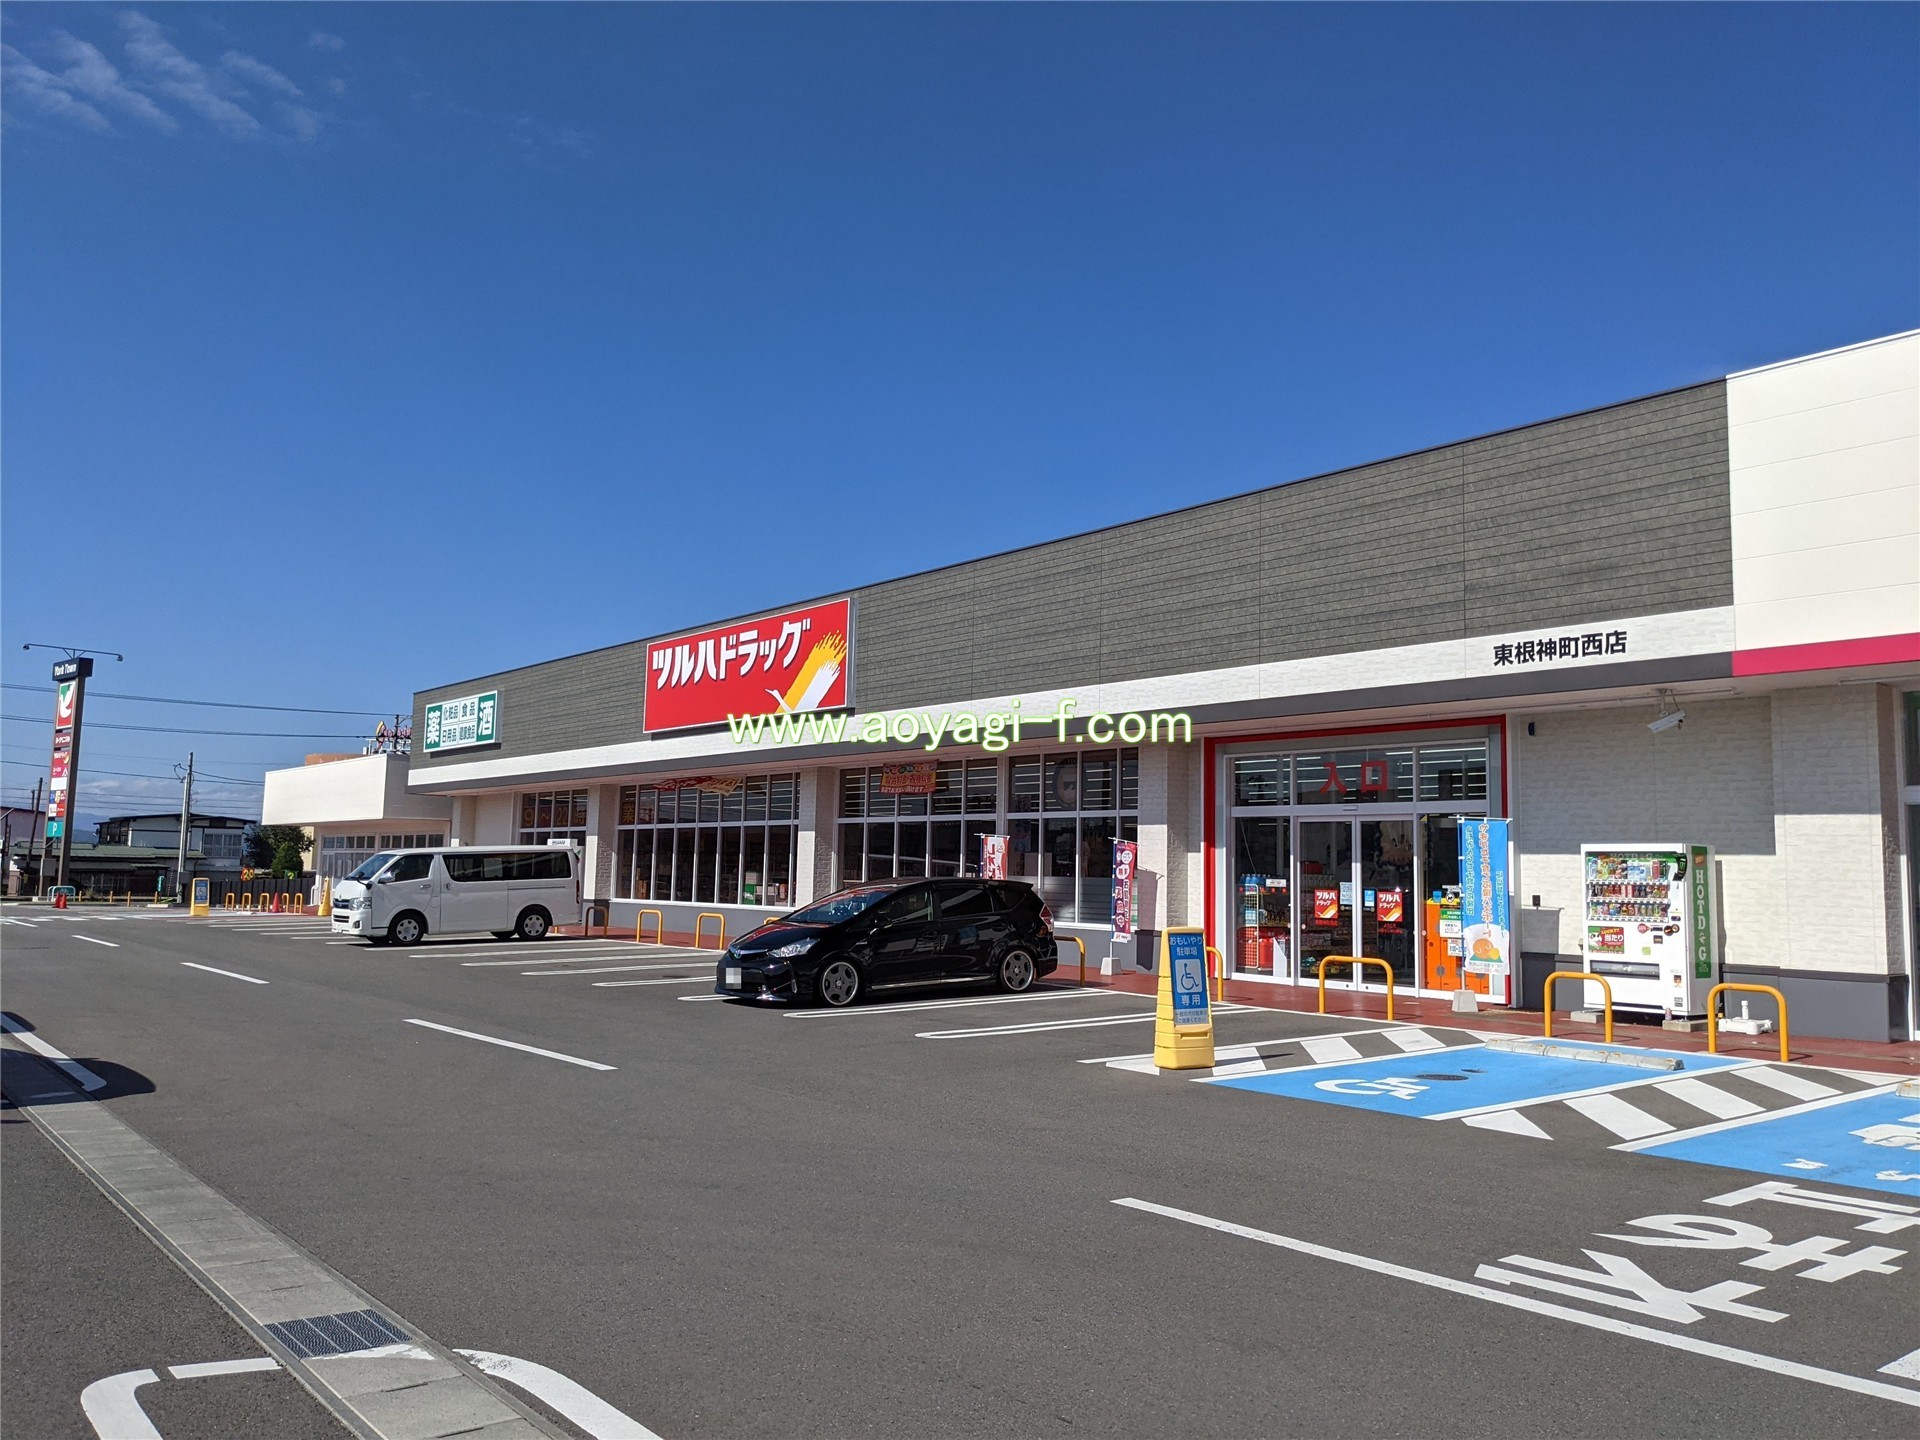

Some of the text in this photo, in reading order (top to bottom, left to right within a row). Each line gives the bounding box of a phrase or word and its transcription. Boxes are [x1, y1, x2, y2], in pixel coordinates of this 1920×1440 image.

[652, 617, 811, 690] ツルハドラッグ
[1493, 630, 1627, 667] 東根神町西店
[443, 704, 459, 721] 化粧品
[461, 701, 475, 718] 食品
[478, 700, 494, 736] 酒
[426, 710, 441, 745] 薬
[442, 727, 457, 743] 日用品
[1319, 759, 1388, 795] 入口
[1316, 891, 1336, 900] ツルハ
[1379, 894, 1401, 902] ツルハ
[1169, 936, 1203, 945] おもいやり
[1604, 933, 1624, 942] 当たり
[1176, 946, 1198, 956] 駐車場
[1181, 994, 1201, 1006] 専用
